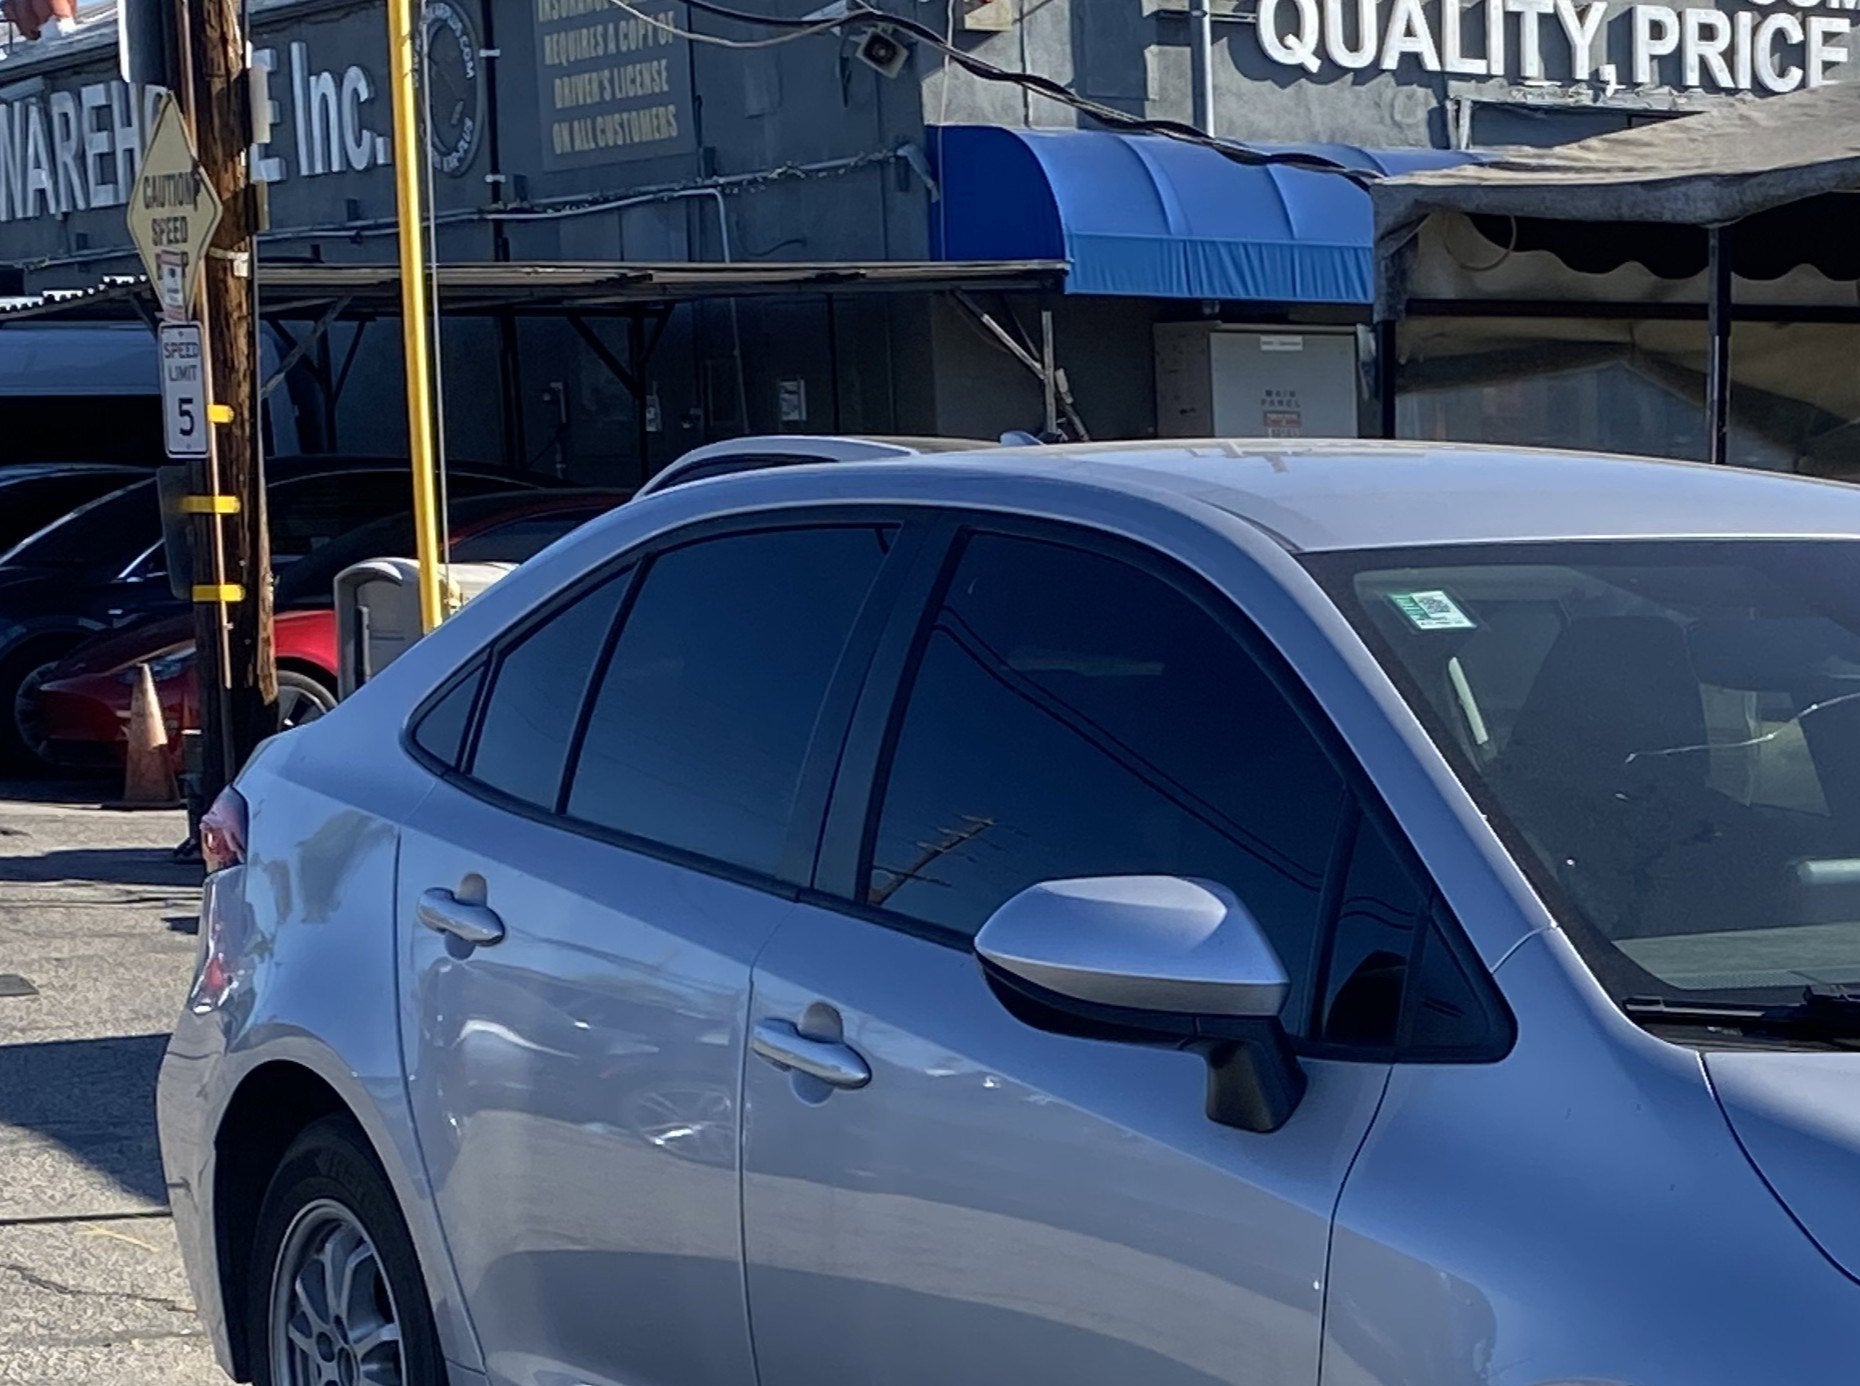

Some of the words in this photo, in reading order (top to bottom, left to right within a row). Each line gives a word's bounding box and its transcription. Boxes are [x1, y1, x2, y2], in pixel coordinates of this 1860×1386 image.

[544, 24, 606, 66] REQUIRES
[607, 22, 617, 54] A
[1632, 4, 1851, 93] PRICE
[613, 59, 669, 99] LICENSE
[290, 42, 386, 176] Inc.
[552, 122, 572, 155] ON
[573, 118, 596, 151] ALL
[595, 104, 678, 148] CUSTOMERS
[143, 172, 199, 211] CAUTION
[152, 216, 189, 247] SPEED
[163, 341, 199, 360] SPEED
[168, 363, 198, 382] LIMIT
[177, 397, 195, 437] 5
